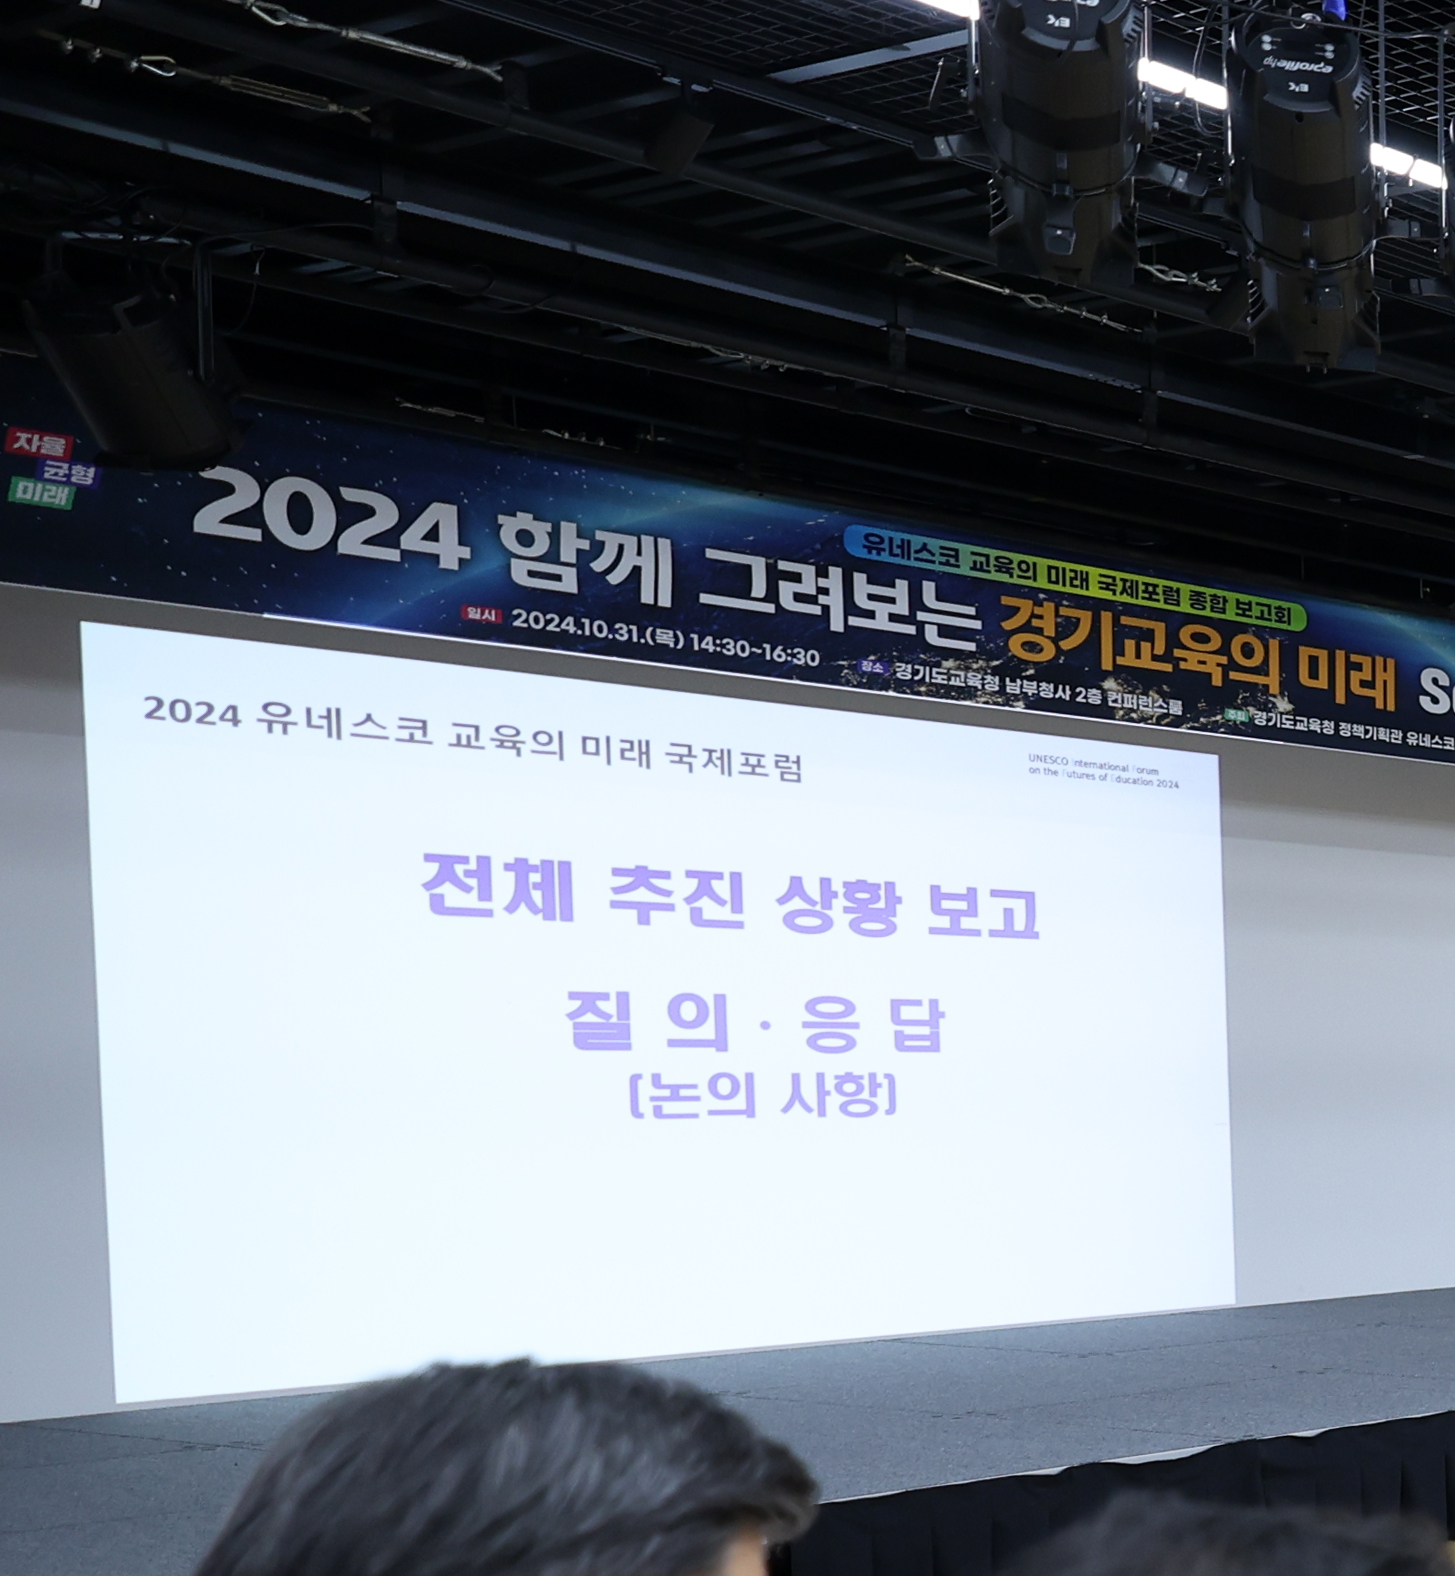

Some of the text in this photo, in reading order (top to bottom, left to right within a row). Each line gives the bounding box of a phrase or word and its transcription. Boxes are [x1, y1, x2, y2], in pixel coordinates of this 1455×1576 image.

[13, 431, 67, 457] 자율
[15, 480, 70, 507] 미래
[41, 460, 95, 485] 균형
[193, 465, 472, 573] 2024
[498, 510, 674, 608] 함께
[699, 547, 983, 652] 그려보는
[1000, 595, 1281, 695] 경기교육의
[1298, 645, 1397, 712] 미래
[862, 532, 1292, 626] 유네스코 교육의 미래 국제포럼 종합 보고회
[467, 607, 821, 668] 일시 2024.10.31.(목) 14:30~16:30
[861, 660, 1184, 717] 장소 경기도교육청 남부청사 2층 컨퍼런스룸
[144, 695, 804, 784] 2024 유네스코 교육의 미래 국제포럼
[1253, 711, 1336, 737] 경기도교육청
[1339, 721, 1403, 745] 정책기획관
[1028, 753, 1069, 766] UNESCO
[1029, 767, 1041, 775] on
[1043, 767, 1059, 777] the
[1098, 773, 1109, 782] of
[1156, 778, 1180, 790] 2024
[421, 851, 1040, 940] 전체 추진 상황 보고
[629, 1071, 897, 1120] (논의 사항)
